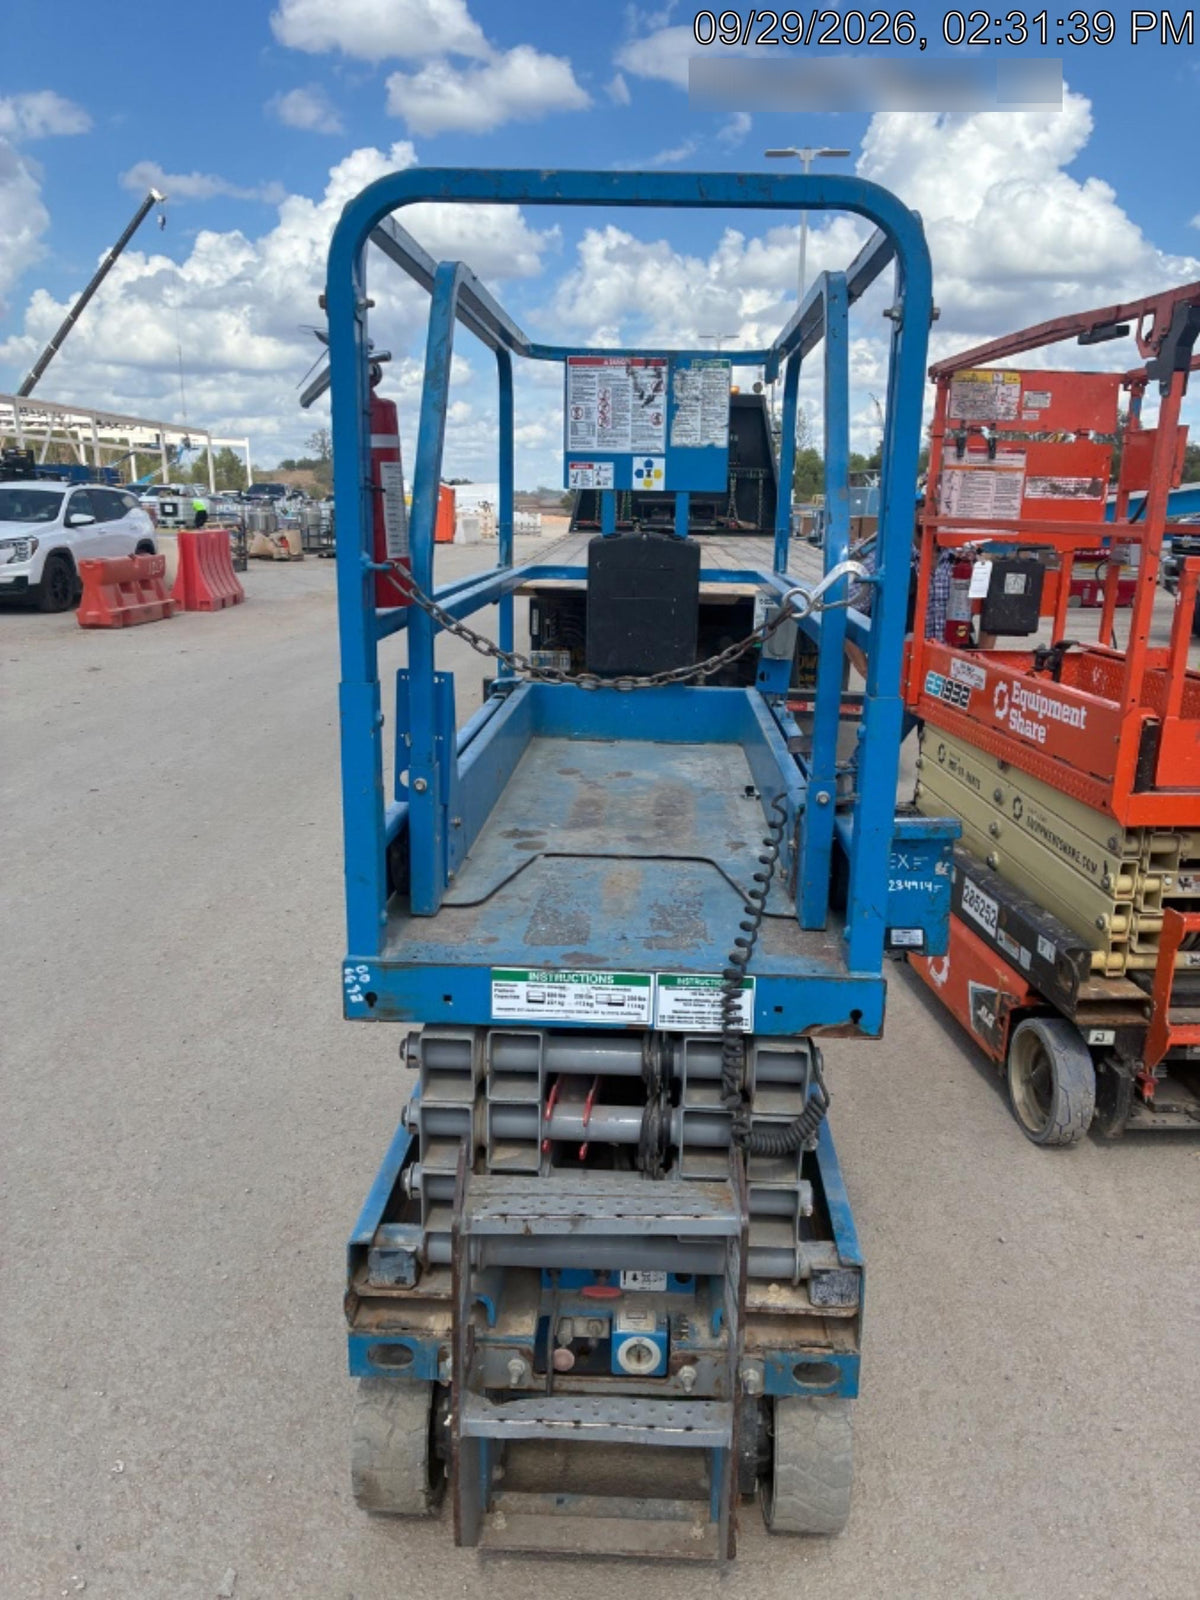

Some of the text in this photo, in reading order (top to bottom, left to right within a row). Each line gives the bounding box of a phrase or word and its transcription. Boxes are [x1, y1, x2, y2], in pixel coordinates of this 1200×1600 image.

[1011, 681, 1087, 729] Equipment
[1009, 708, 1046, 744] Share
[528, 972, 614, 984] INSTRUCTIONS
